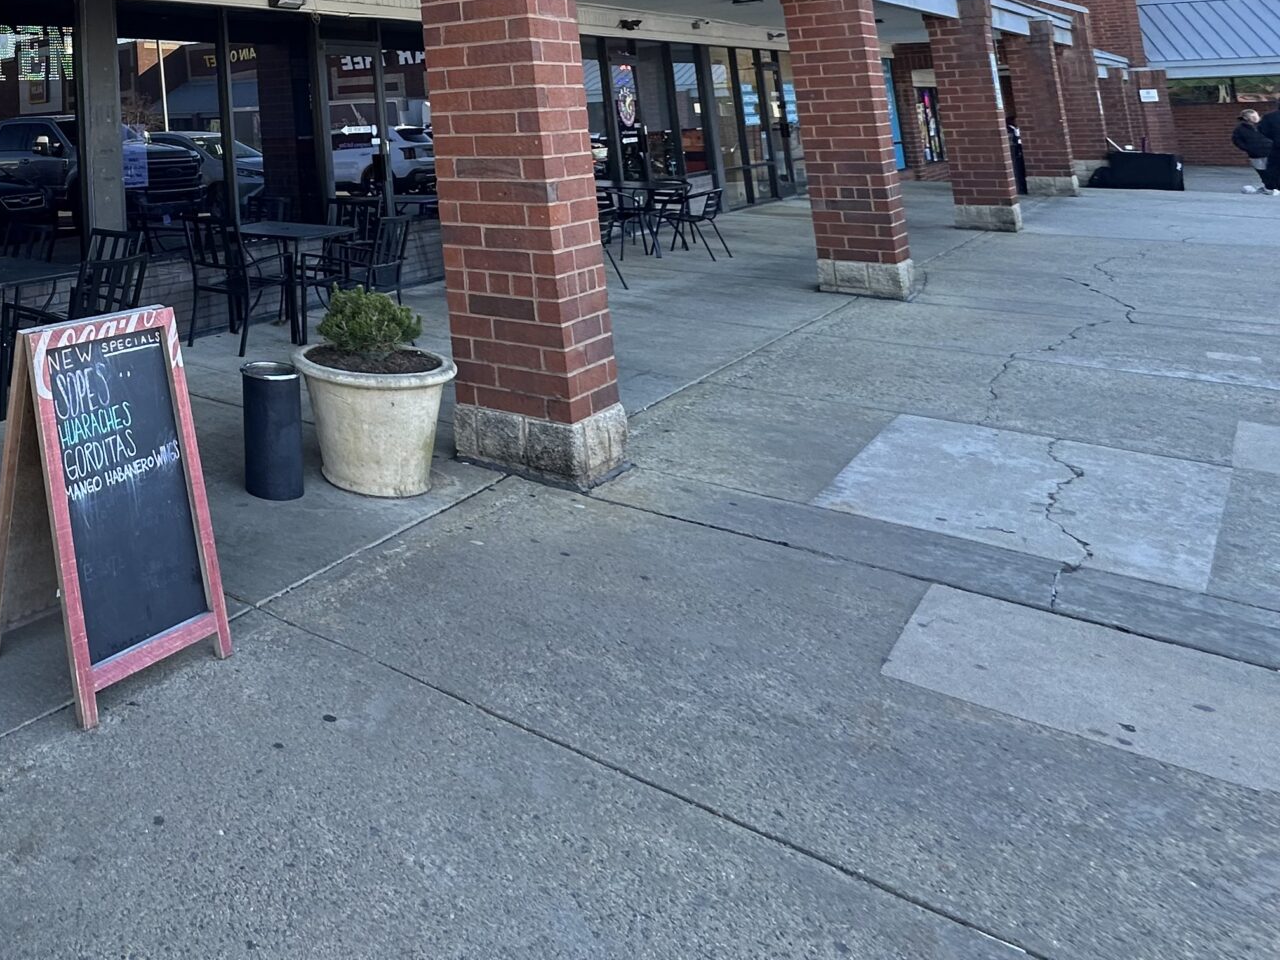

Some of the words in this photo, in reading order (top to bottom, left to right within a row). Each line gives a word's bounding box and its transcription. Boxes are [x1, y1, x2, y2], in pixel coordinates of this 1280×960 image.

[47, 343, 92, 374] NEW
[101, 332, 160, 353] SPECIALS
[55, 362, 110, 419] SOPES
[58, 402, 131, 449] HUARACHES
[64, 429, 136, 480] GORDITAS
[65, 476, 102, 500] MANGO
[105, 456, 154, 486] HABANERO
[152, 440, 179, 468] WINGS
